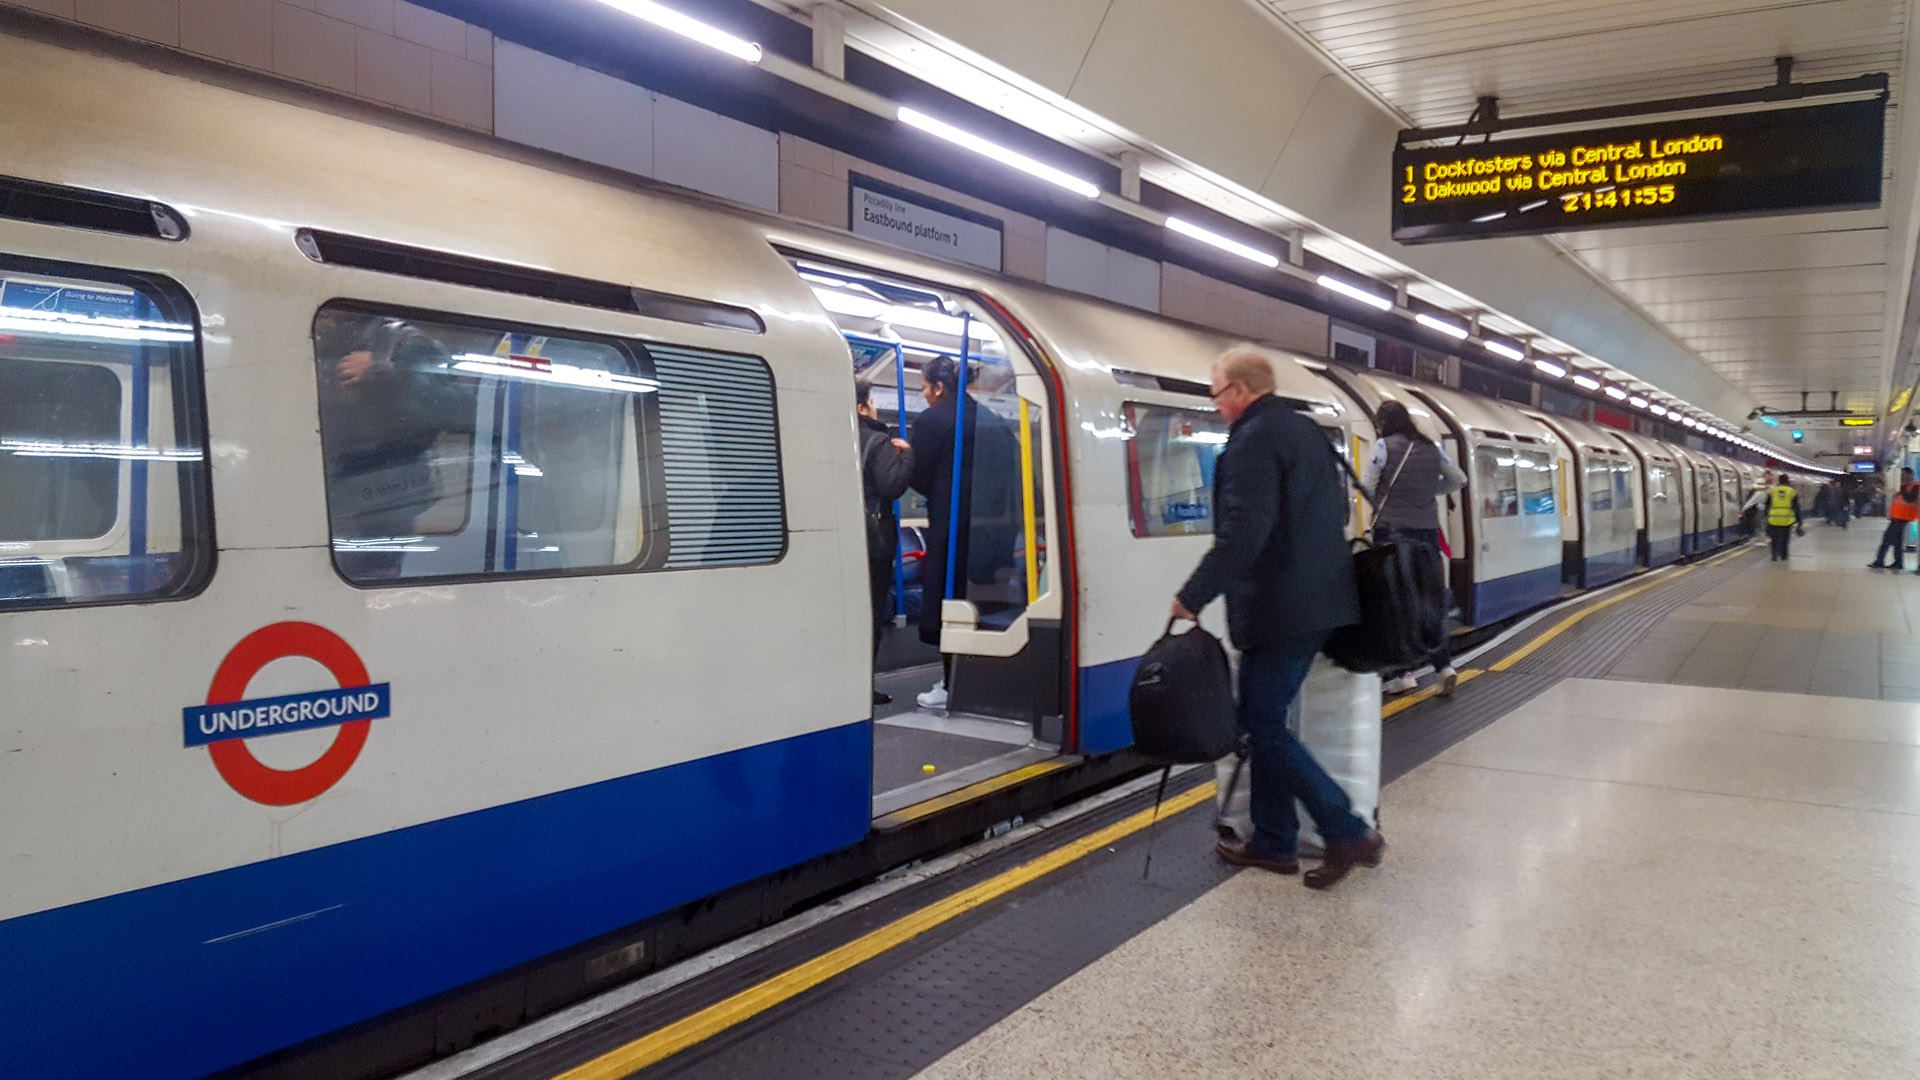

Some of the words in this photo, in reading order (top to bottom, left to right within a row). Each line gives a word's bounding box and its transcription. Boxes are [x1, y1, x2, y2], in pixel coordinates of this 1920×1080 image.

[1405, 165, 1414, 184] 1
[1424, 155, 1533, 182] Cockfosters
[1538, 150, 1566, 168] via
[1572, 140, 1644, 167] Central
[1650, 134, 1723, 159] London
[1402, 184, 1417, 204] 2
[1424, 176, 1500, 201] Oakwood
[1506, 174, 1533, 191] via
[1537, 165, 1609, 190] Central
[1615, 160, 1687, 183] London
[1562, 183, 1675, 213] 21:41:55
[864, 193, 893, 212] Piccadilly
[894, 203, 906, 214] line
[864, 207, 912, 234] Eastbound
[914, 224, 951, 246] platform
[953, 233, 959, 247] 2
[65, 291, 86, 300] Going
[199, 693, 379, 735] UNDERGROUND
